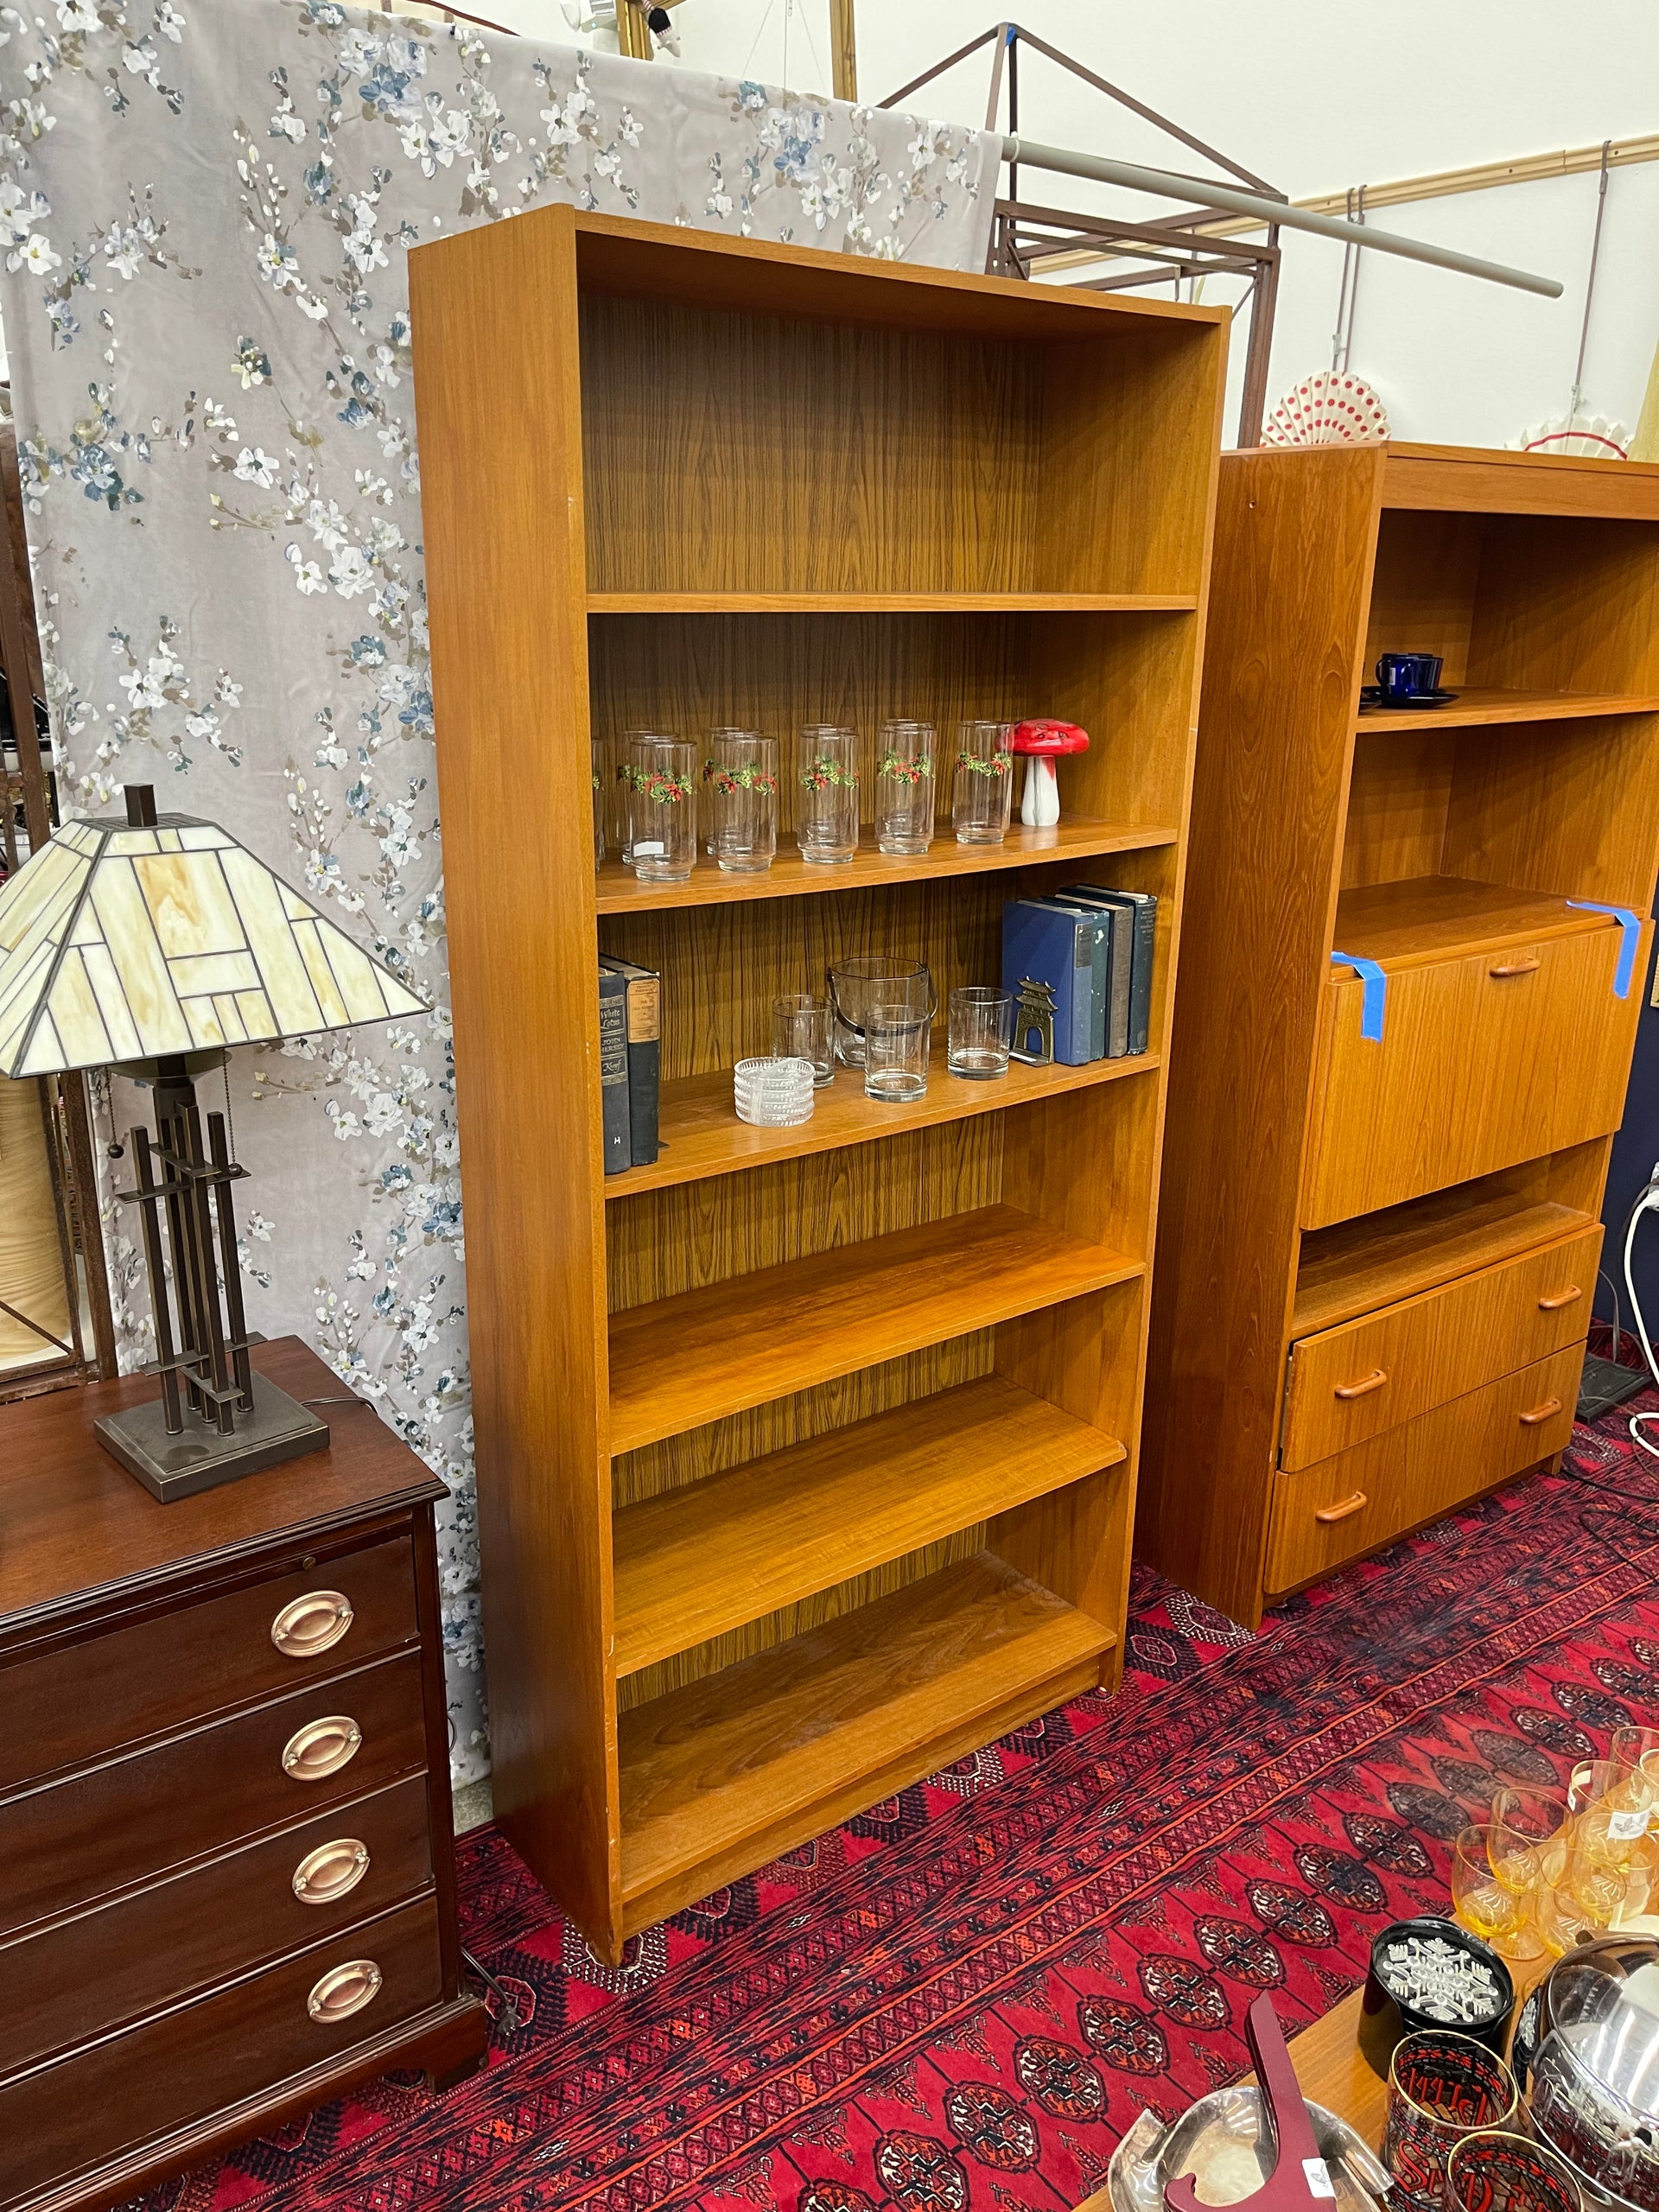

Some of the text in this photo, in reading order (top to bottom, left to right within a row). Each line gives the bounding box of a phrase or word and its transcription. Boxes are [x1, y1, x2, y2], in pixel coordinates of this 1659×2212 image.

[601, 1008, 620, 1019] White
[601, 1019, 620, 1029] Lotus
[613, 1136, 621, 1146] H
